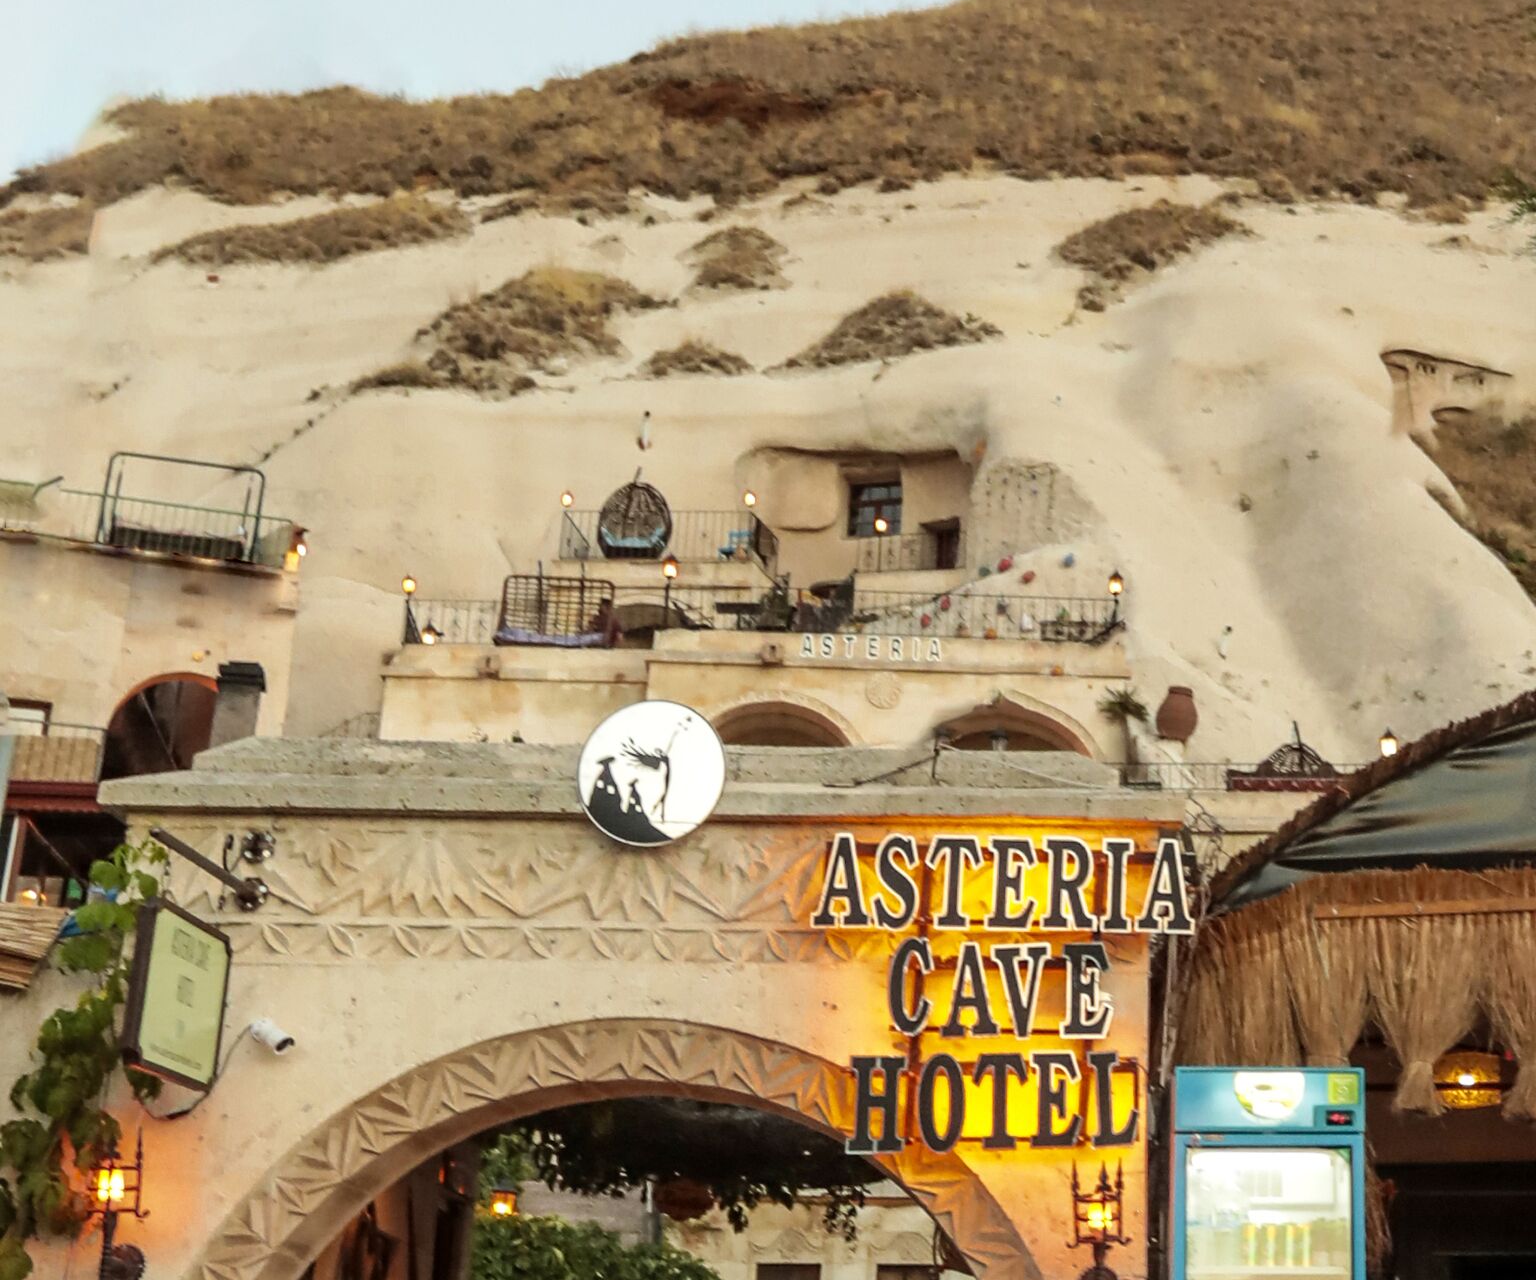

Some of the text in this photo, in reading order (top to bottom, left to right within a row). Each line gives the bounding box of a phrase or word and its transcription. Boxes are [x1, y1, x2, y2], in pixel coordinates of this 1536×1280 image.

[800, 633, 942, 662] ASTERIA
[811, 832, 1195, 935] ASTERIA
[888, 937, 1114, 1038] CAVE
[845, 1050, 1139, 1154] HOTEL
